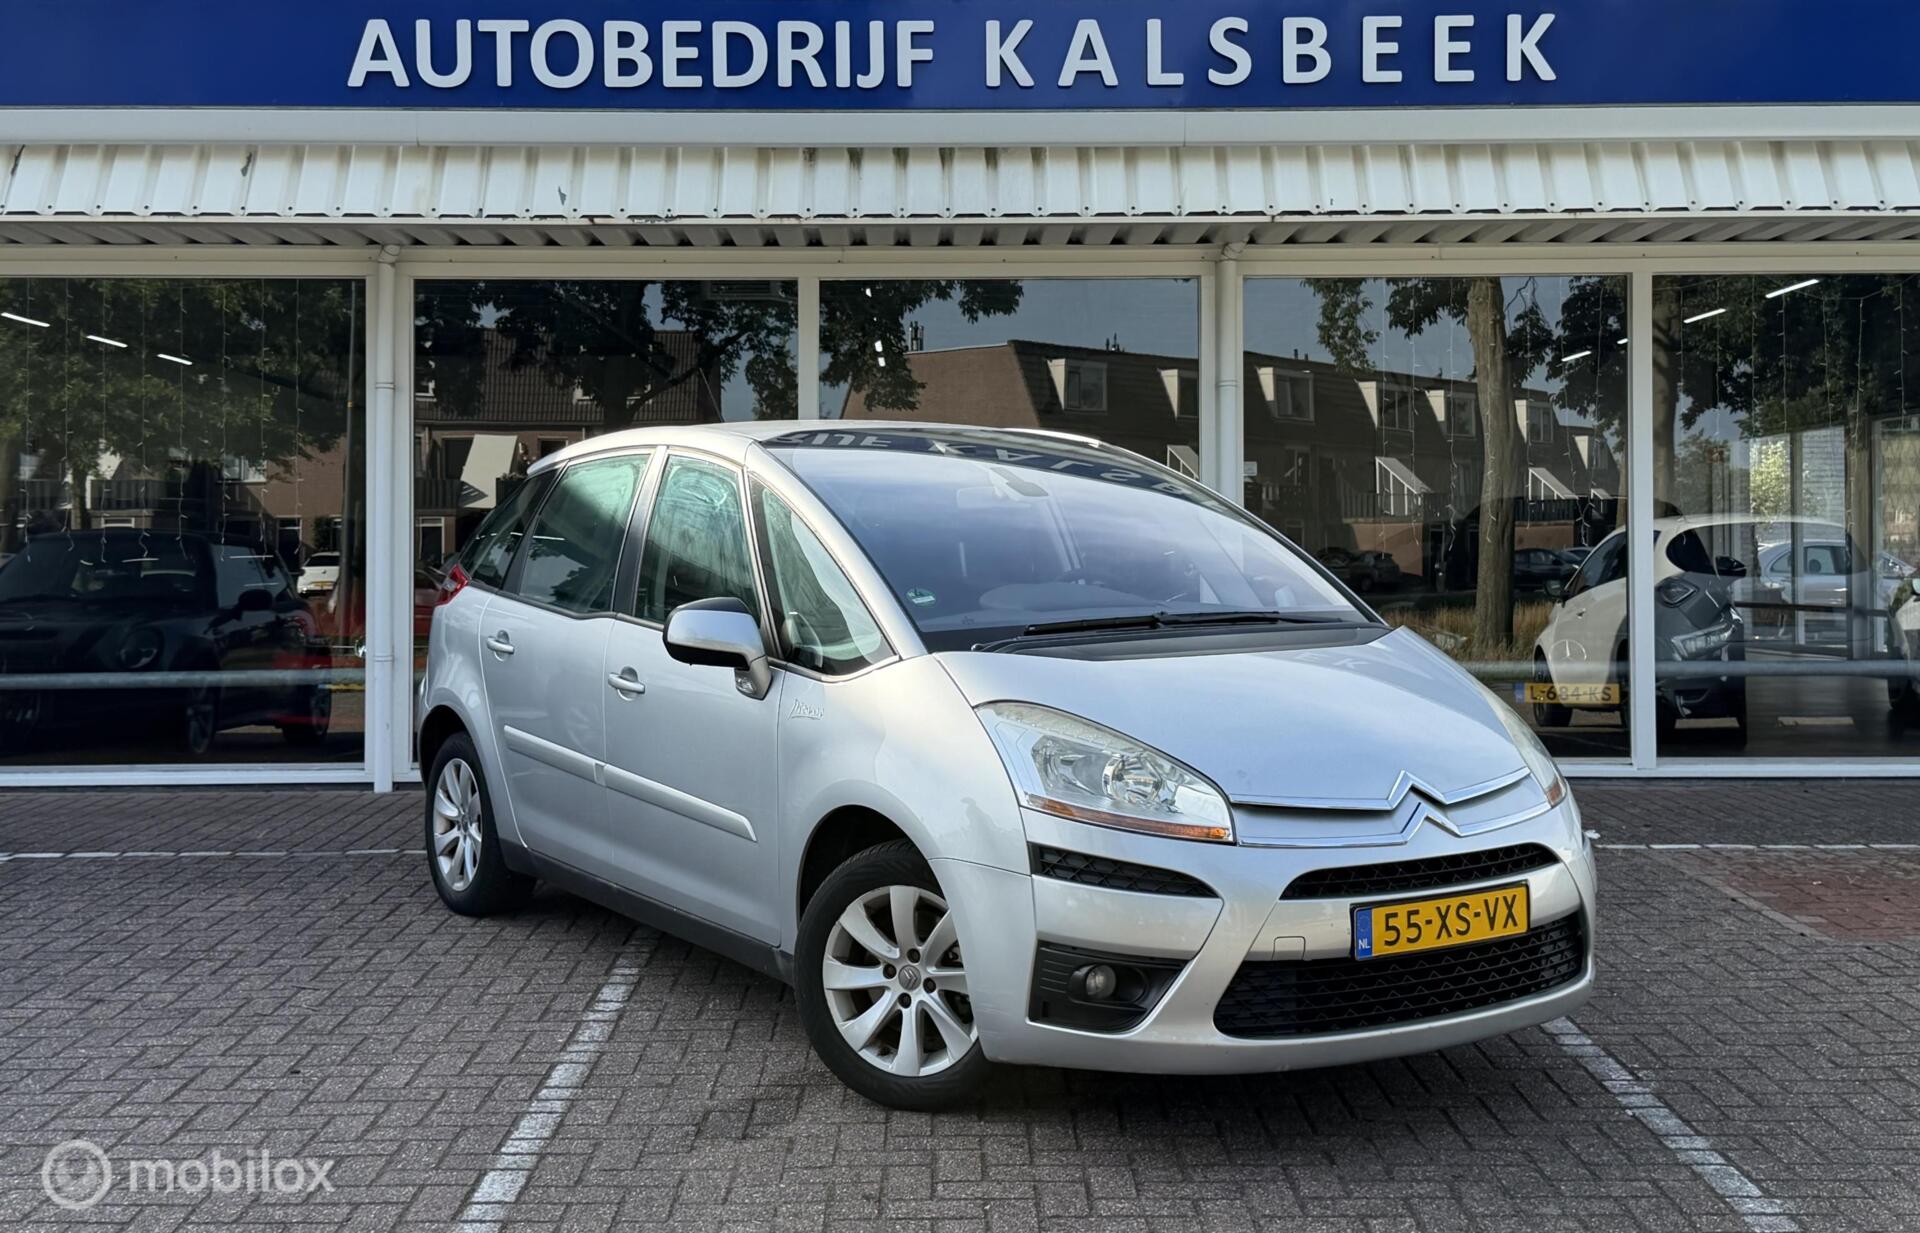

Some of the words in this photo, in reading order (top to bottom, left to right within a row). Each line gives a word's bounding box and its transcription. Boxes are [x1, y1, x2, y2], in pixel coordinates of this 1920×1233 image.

[347, 19, 934, 89] AUTOBEDRIJF
[985, 13, 1557, 87] KALSBEEK
[1530, 686, 1612, 701] L-684-KS
[1358, 938, 1370, 949] NL
[1384, 894, 1518, 947] 55-XS-VX
